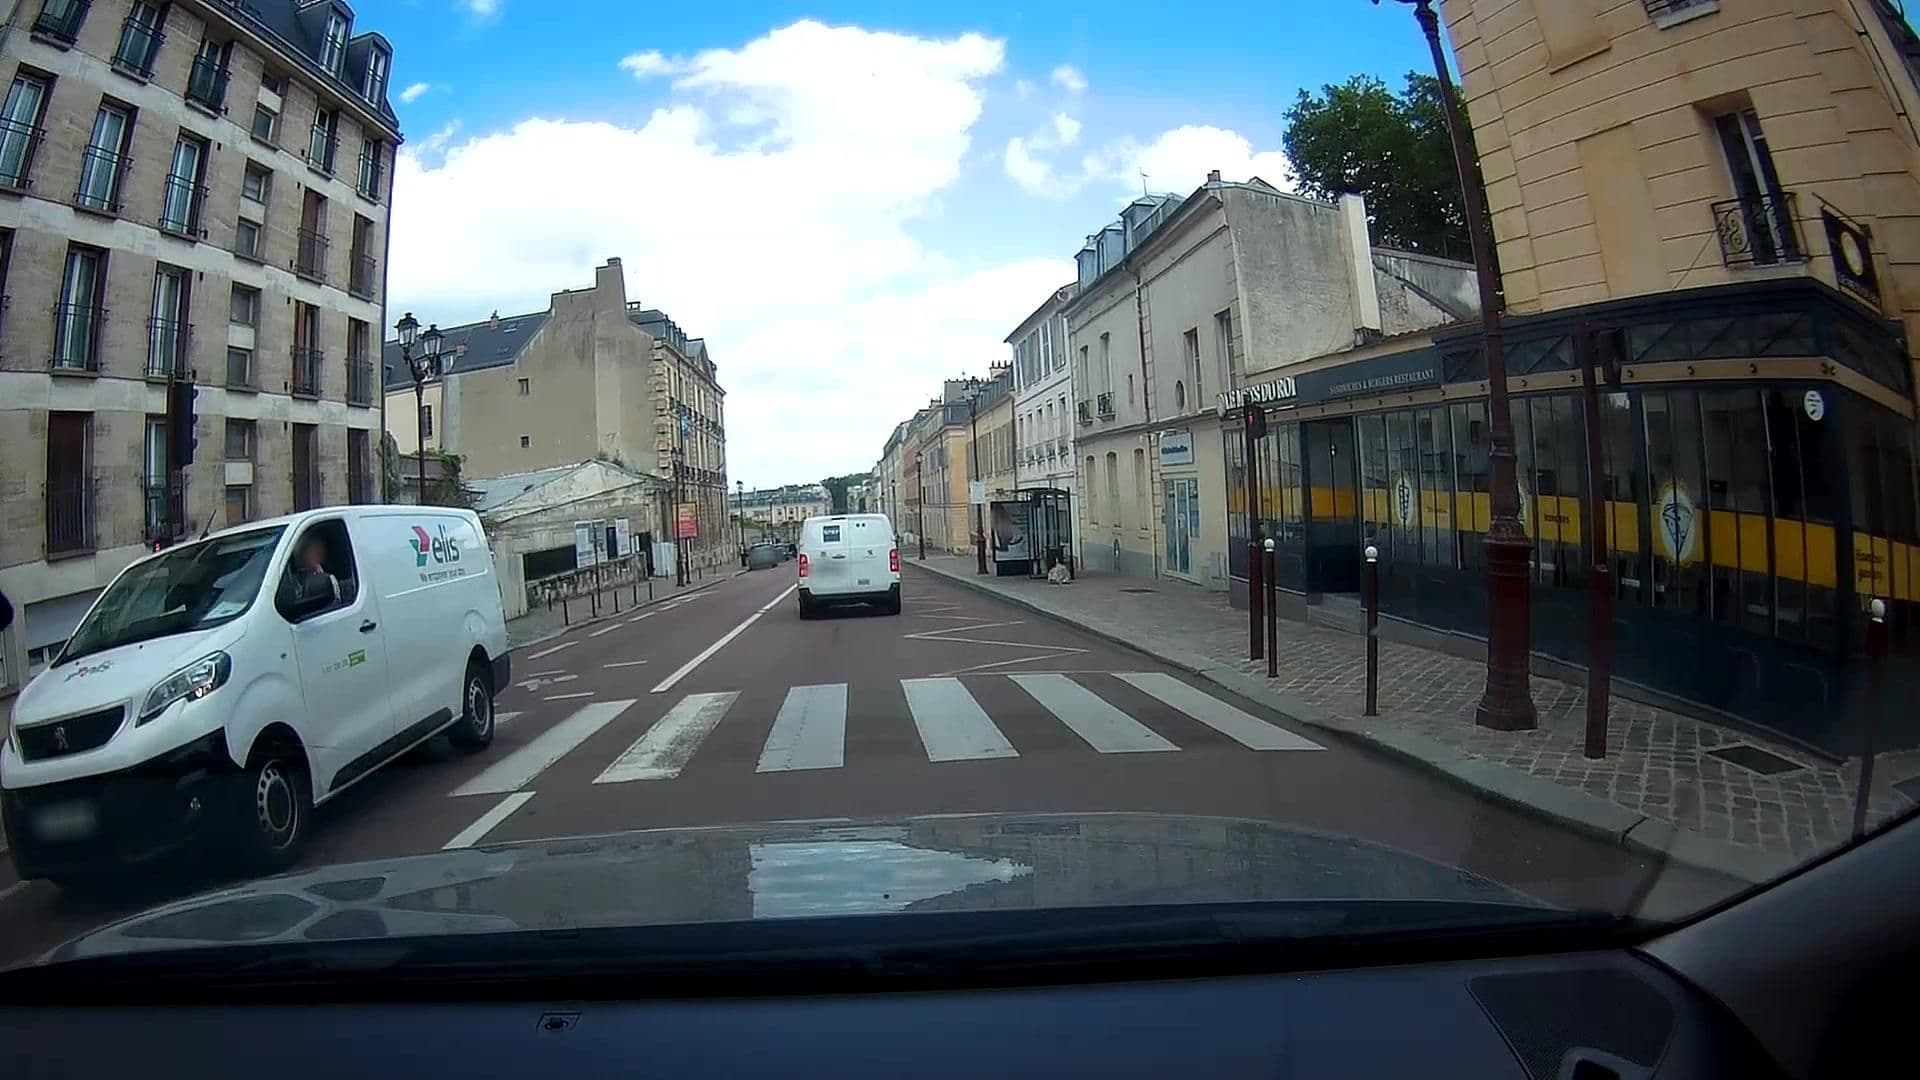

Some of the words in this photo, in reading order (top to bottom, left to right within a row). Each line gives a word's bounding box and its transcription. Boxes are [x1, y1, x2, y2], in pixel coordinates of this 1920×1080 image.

[1224, 389, 1236, 410] LE
[1261, 380, 1277, 402] DU
[1277, 376, 1297, 399] ROI
[1368, 376, 1393, 389] BURGERS
[1394, 368, 1435, 384] RESTAURANT
[431, 524, 460, 564] elis
